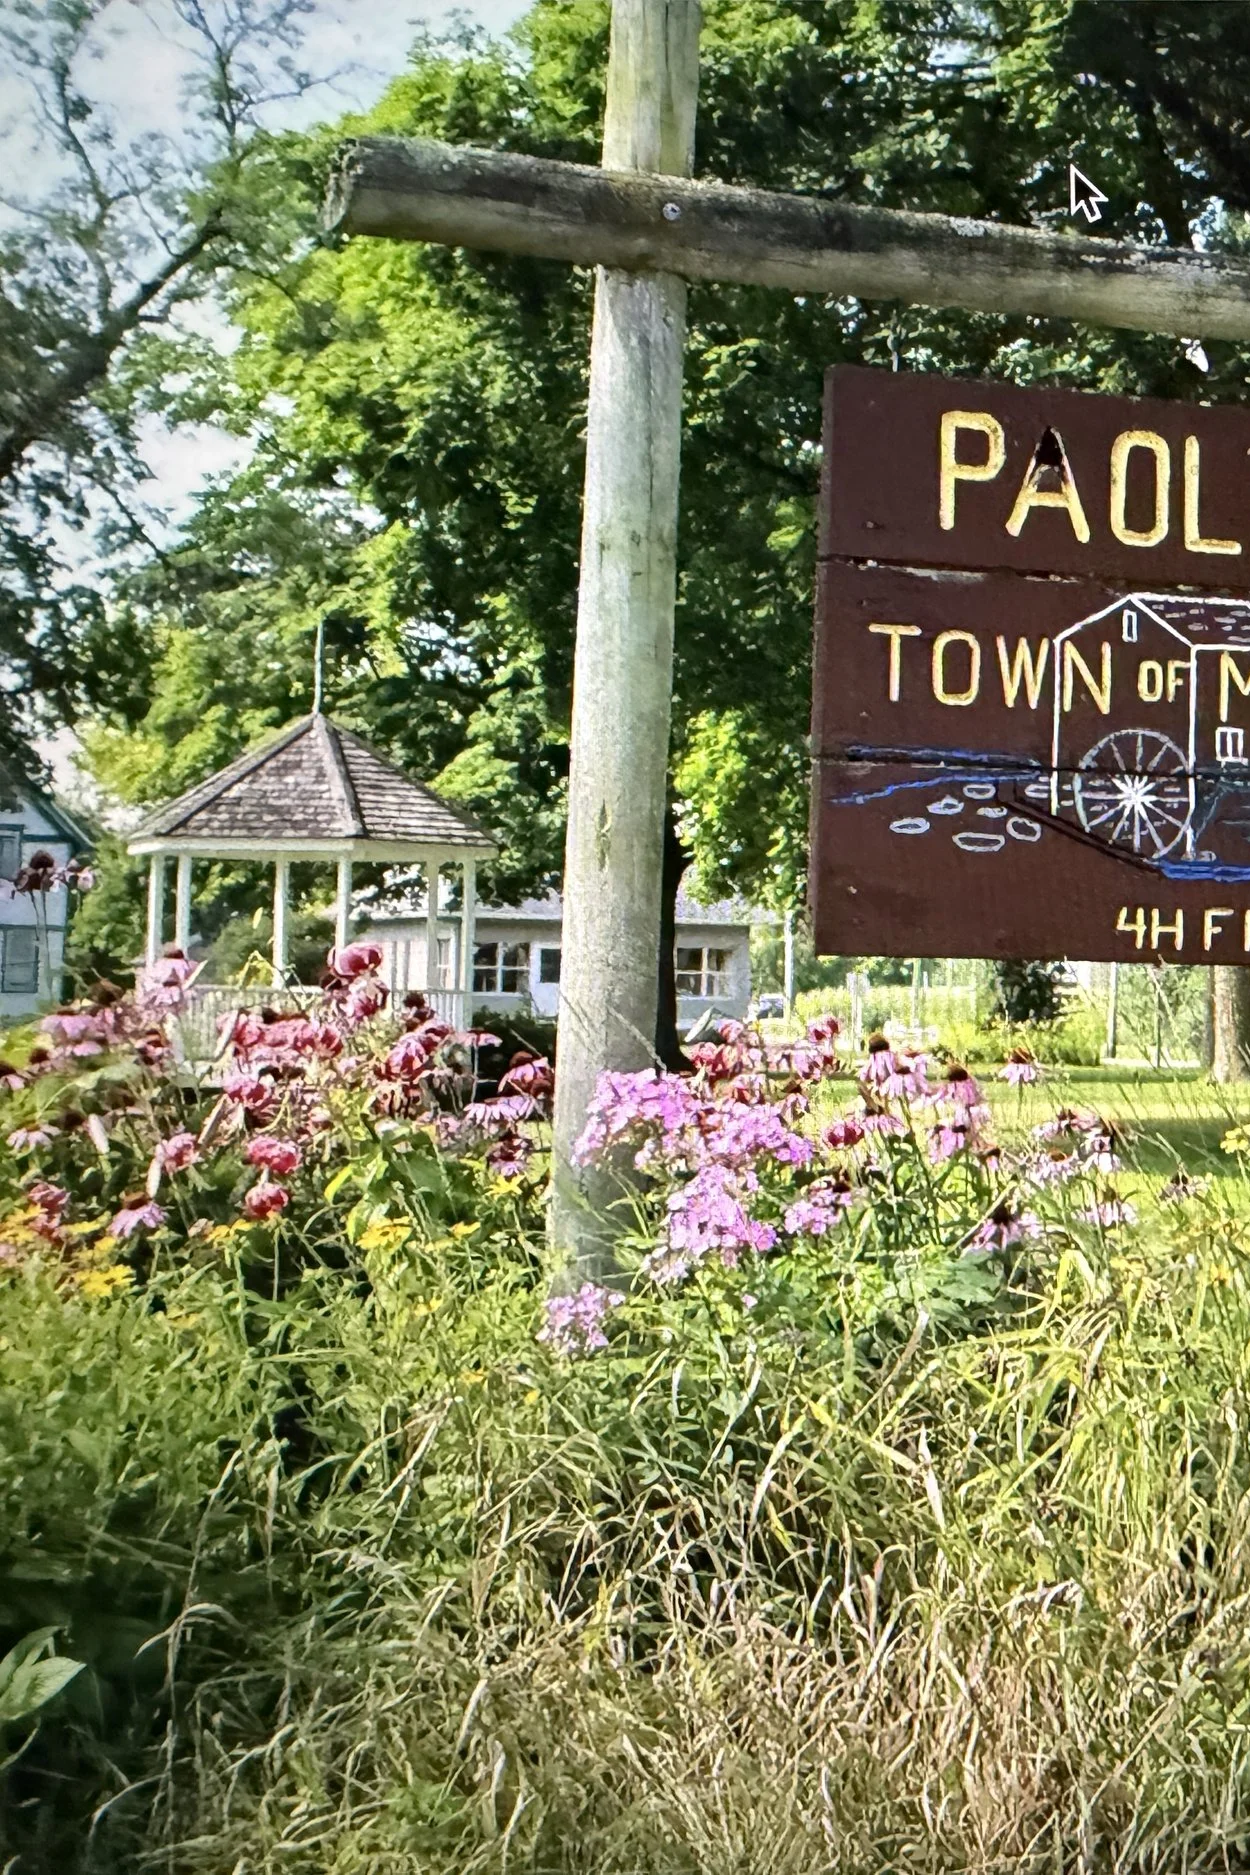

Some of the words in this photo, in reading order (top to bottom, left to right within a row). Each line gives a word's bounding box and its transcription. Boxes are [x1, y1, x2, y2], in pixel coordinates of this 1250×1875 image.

[869, 623, 1112, 715] TOWN
[1138, 660, 1188, 702] OF
[1116, 906, 1184, 951] 4H
